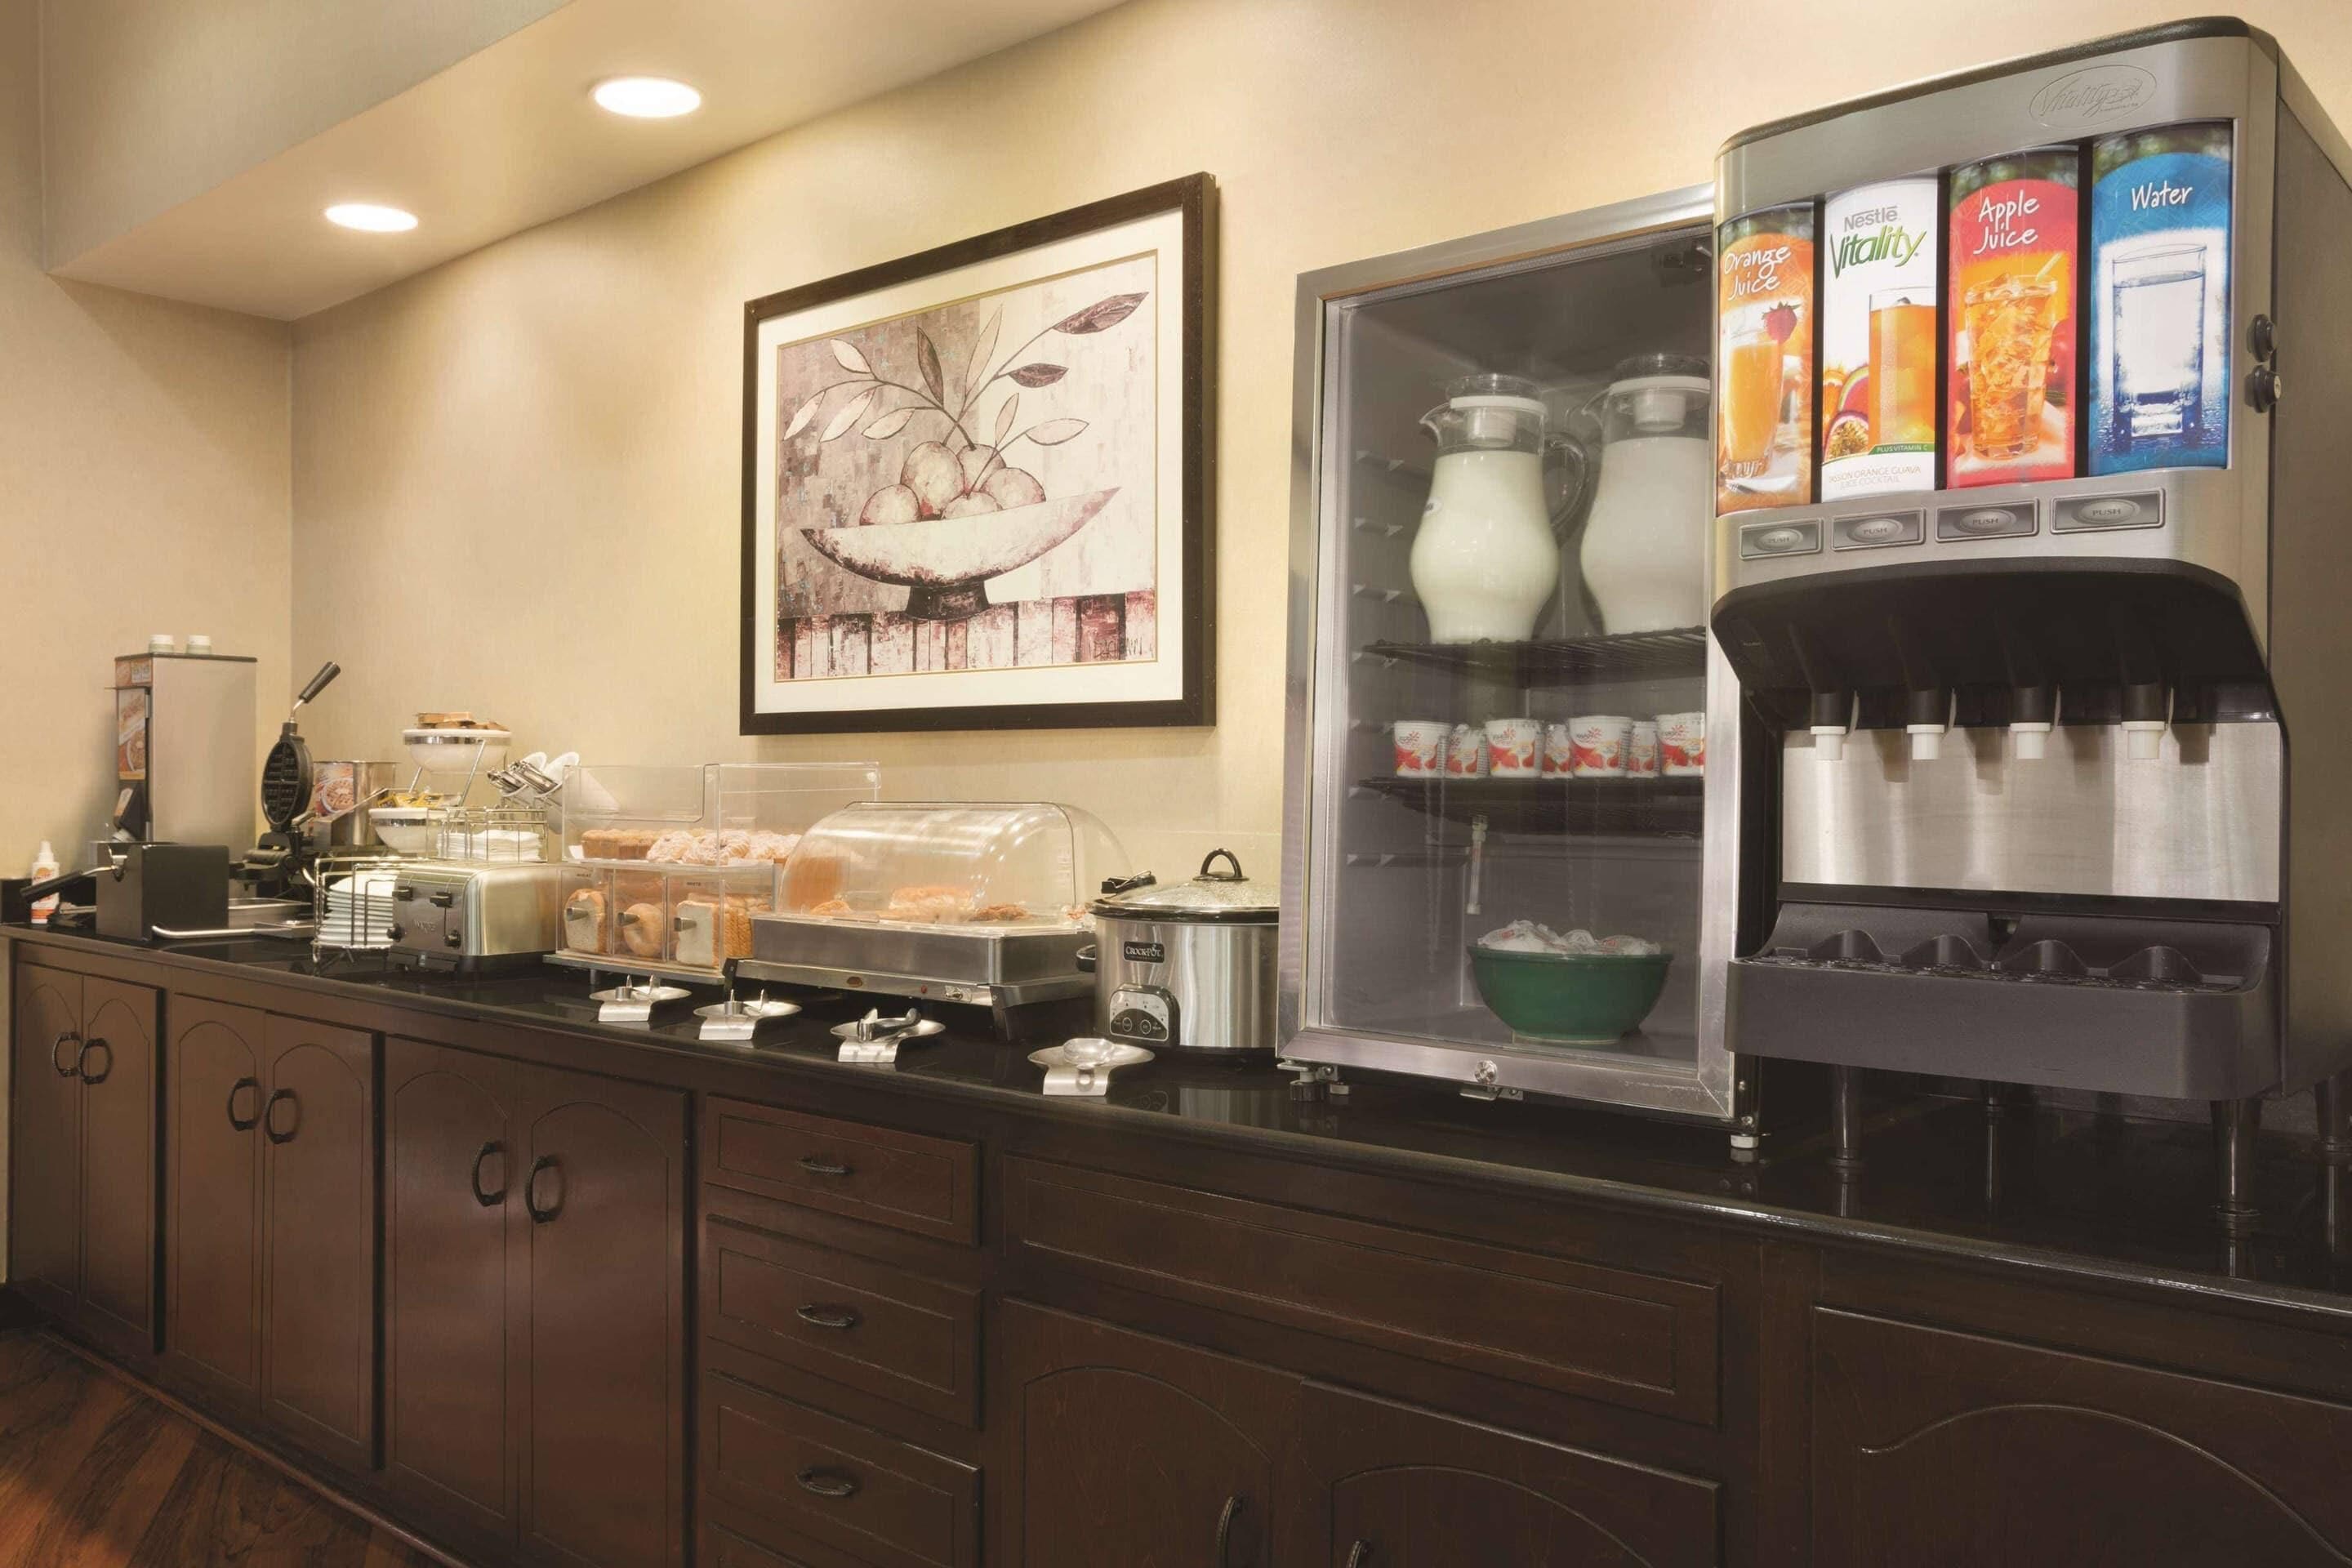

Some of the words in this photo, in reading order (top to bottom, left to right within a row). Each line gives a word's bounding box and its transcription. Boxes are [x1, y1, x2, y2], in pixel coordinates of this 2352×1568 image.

[2131, 180, 2193, 211] Water
[1978, 189, 2040, 233] Apple
[1830, 225, 1927, 279] Vitality
[1972, 223, 2038, 255] Juice
[1724, 247, 1791, 280] Orange
[1727, 271, 1781, 301] Juice
[1854, 467, 1890, 479] ORANGE
[1891, 466, 1922, 474] GUAVA
[1971, 517, 1999, 525] PUSH
[2091, 509, 2122, 517] PUSH
[1863, 527, 1888, 536] PUSH
